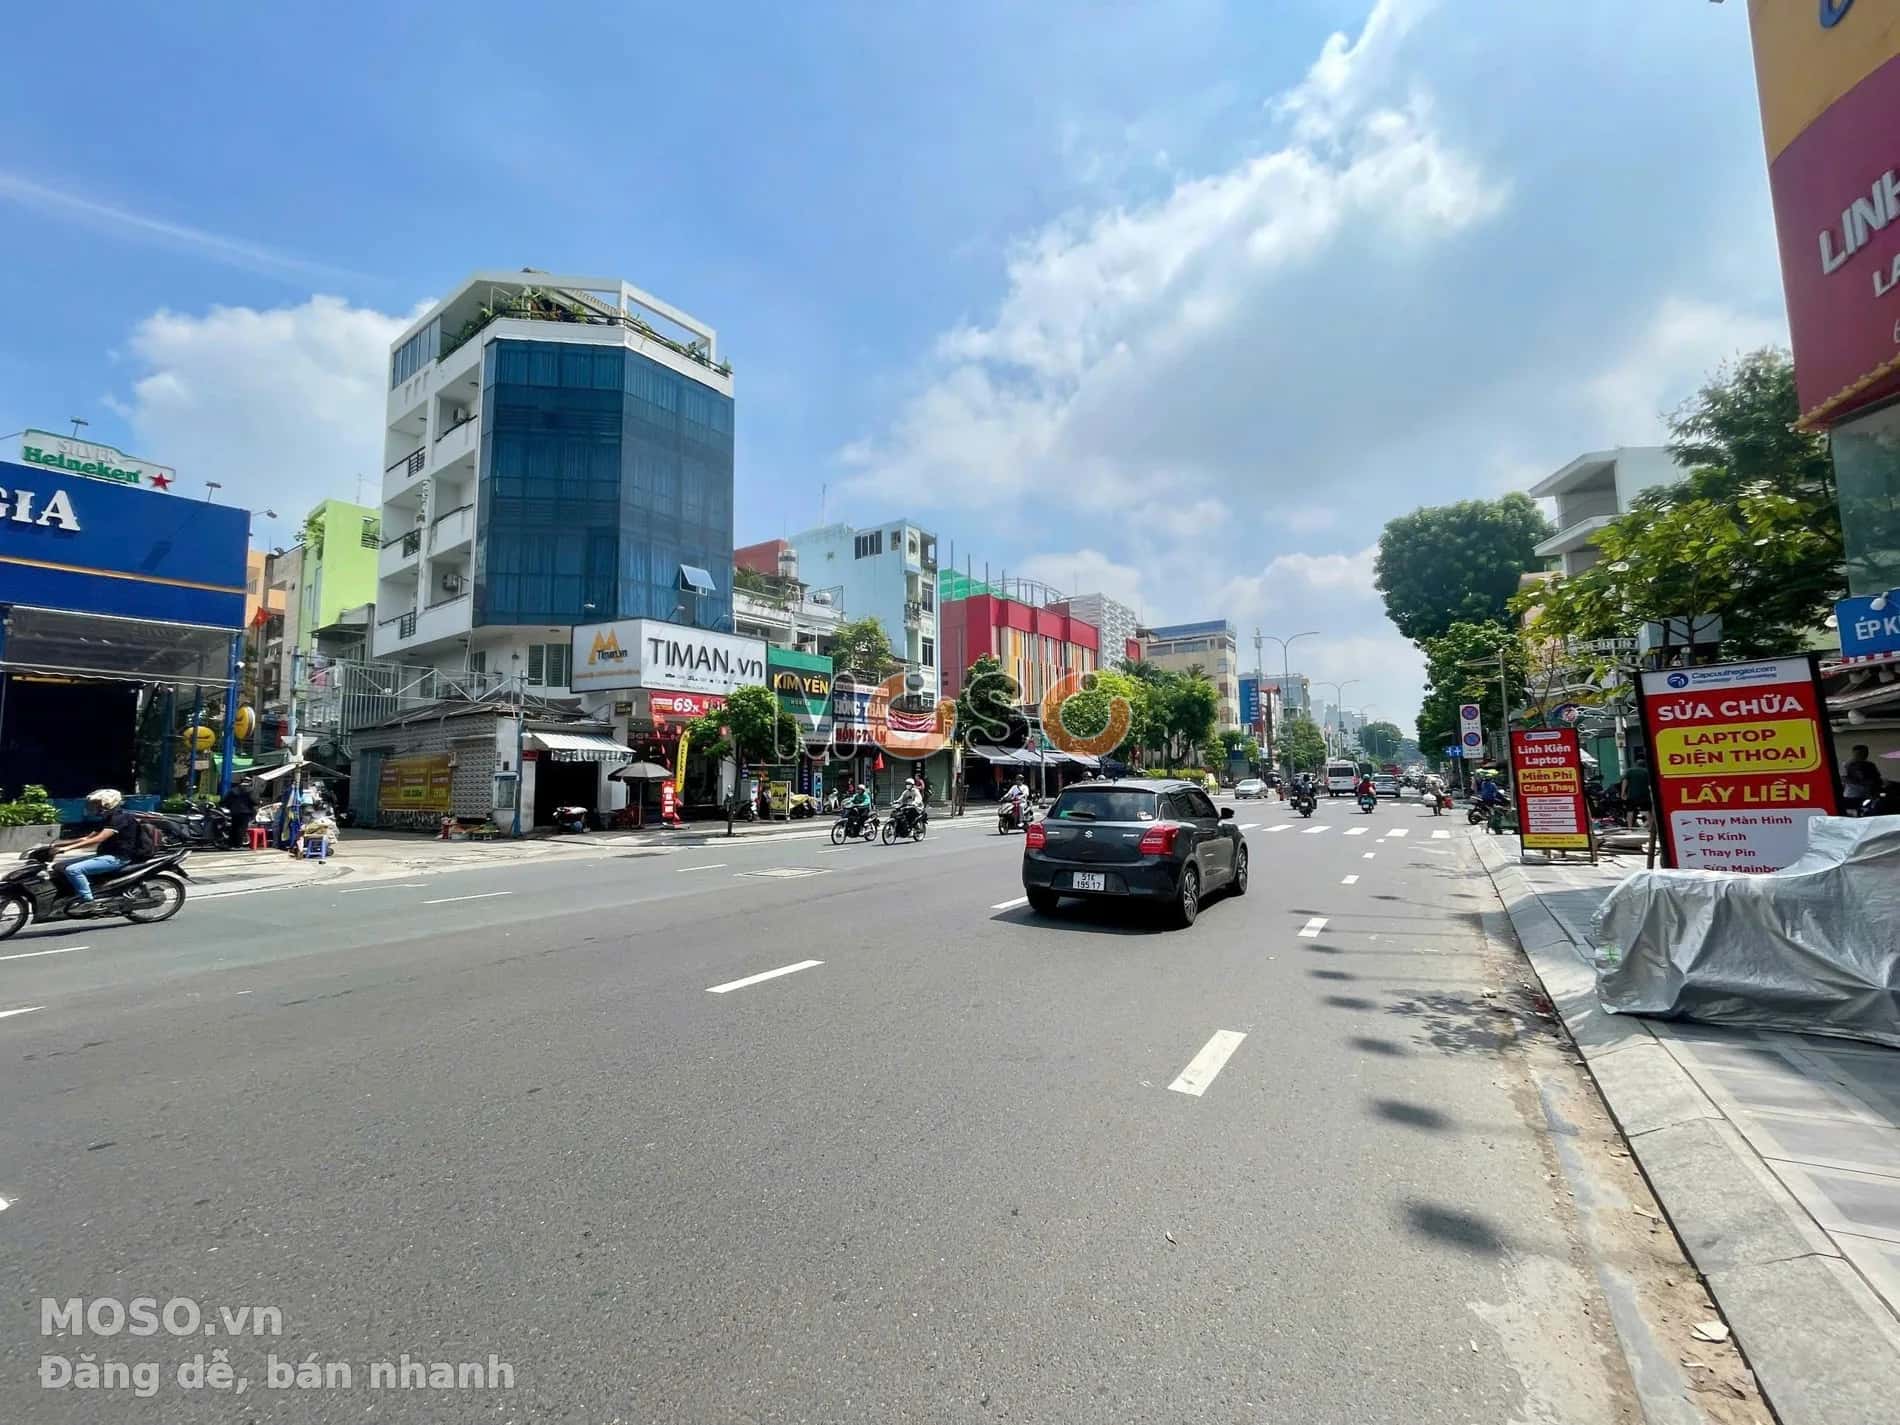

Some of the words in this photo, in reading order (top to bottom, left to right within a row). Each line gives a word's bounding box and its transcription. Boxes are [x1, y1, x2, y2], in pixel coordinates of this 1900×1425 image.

[23, 446, 140, 483] Heineken
[1855, 616, 1881, 640] ÉP
[1883, 616, 1900, 636] K
[648, 637, 763, 678] TIMAN.vn
[773, 673, 799, 691] KIM
[803, 674, 828, 694] YẾN
[1658, 700, 1714, 721] SỬA
[1720, 694, 1804, 717] CHỮA
[1684, 728, 1777, 746] LAPTOP
[1518, 745, 1542, 754] Linh
[1668, 749, 1724, 768] ĐIỆN
[1730, 746, 1806, 764] THOẠI
[1525, 757, 1565, 766] Laptop
[1551, 783, 1575, 793] Thay
[1680, 780, 1735, 804] LẤY
[1743, 779, 1811, 802] LIỀN
[1696, 816, 1726, 827] Thay
[1762, 815, 1793, 825] Hình
[1718, 832, 1747, 841] Kính
[1700, 847, 1731, 858] Thay
[1735, 847, 1756, 857] Pin
